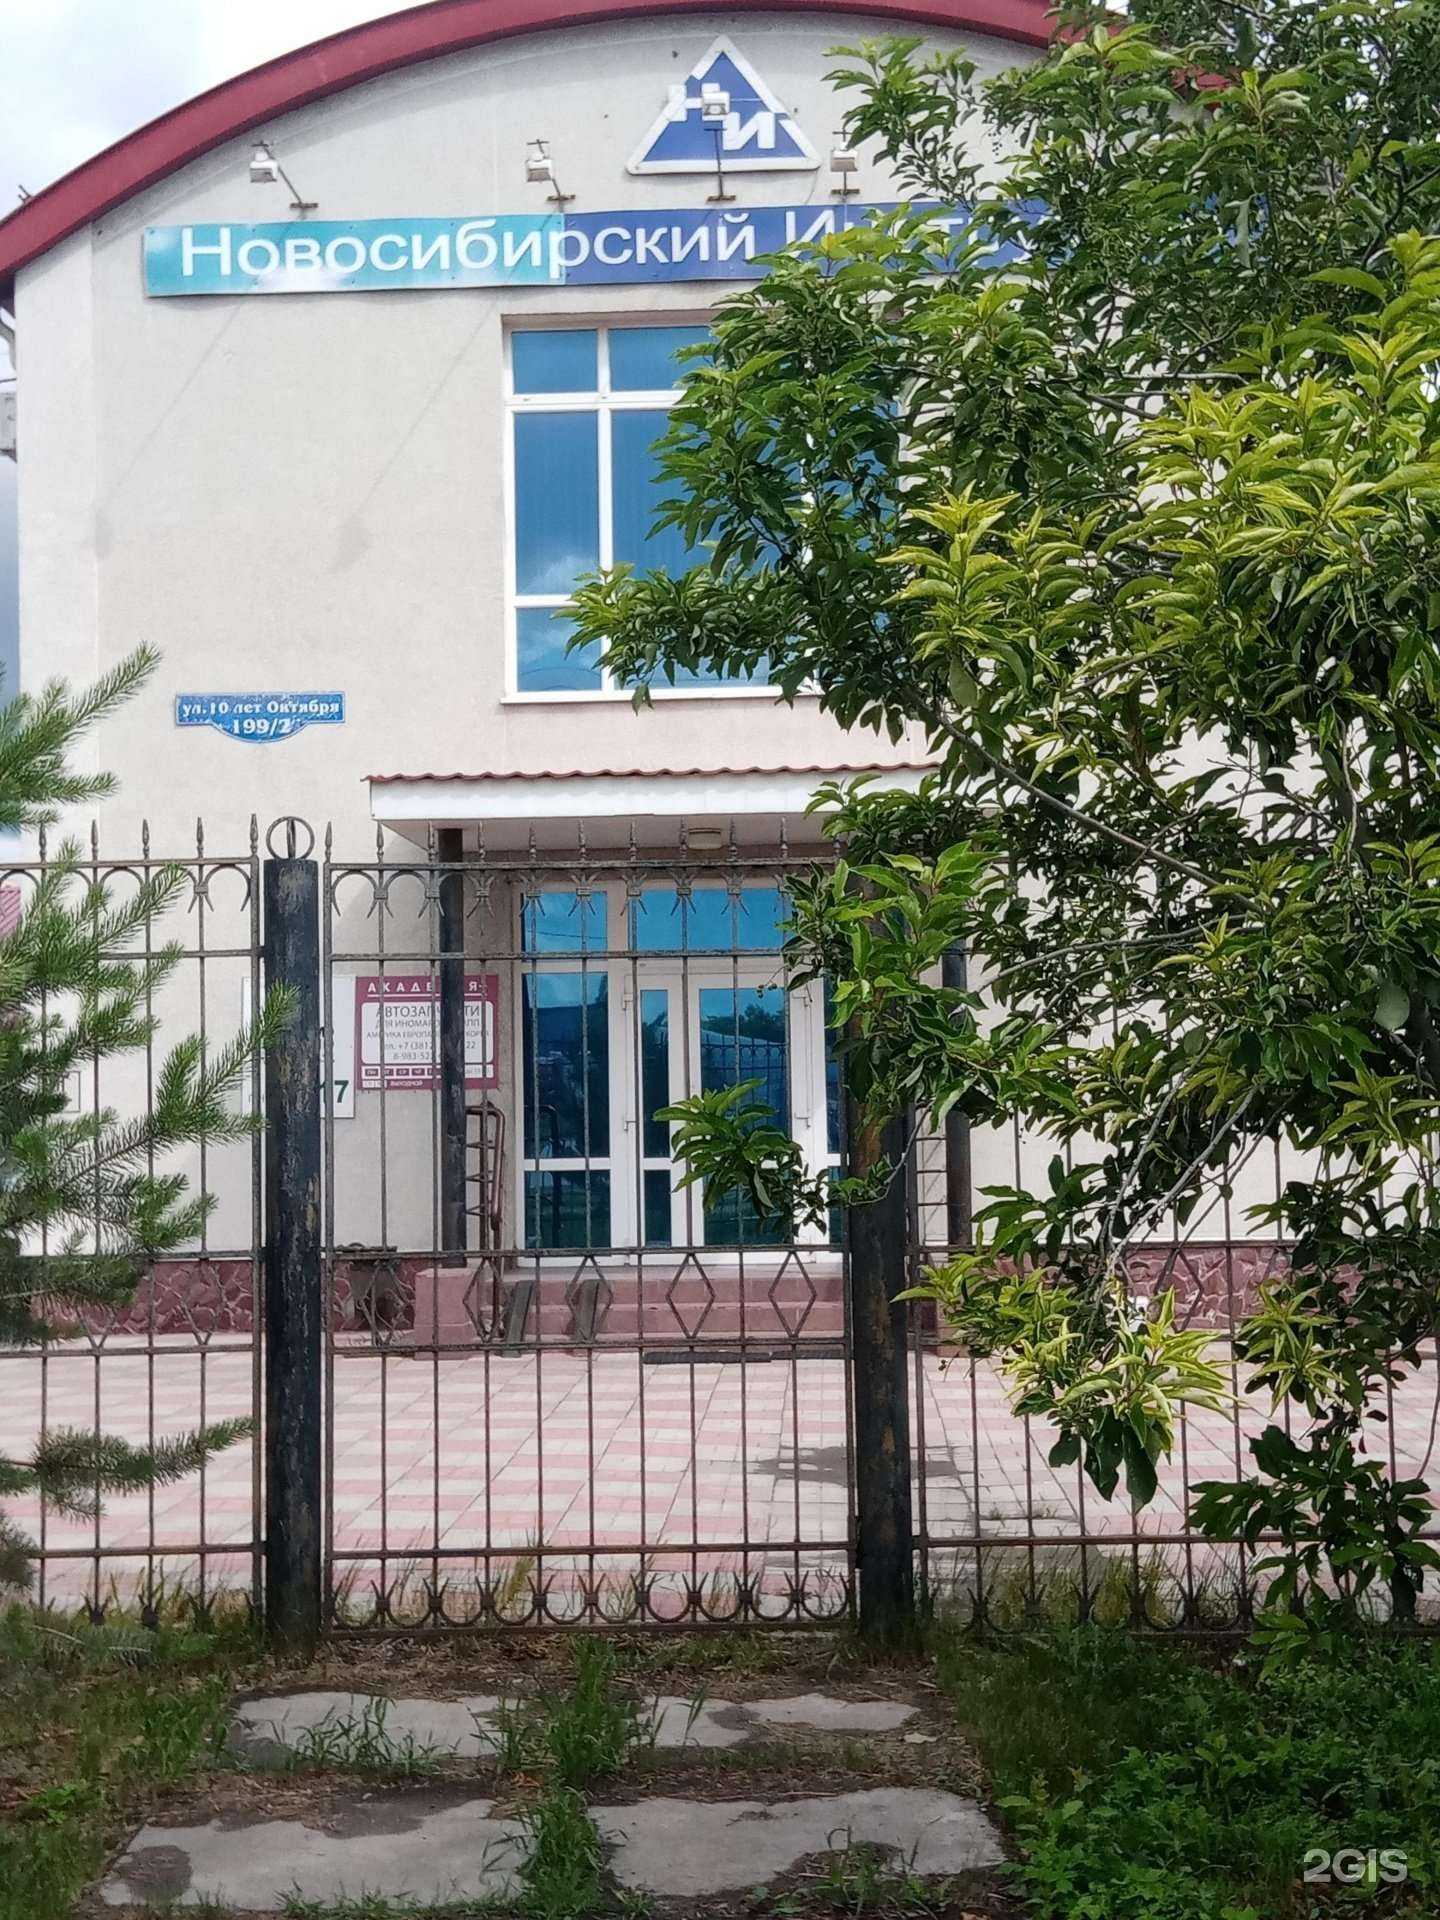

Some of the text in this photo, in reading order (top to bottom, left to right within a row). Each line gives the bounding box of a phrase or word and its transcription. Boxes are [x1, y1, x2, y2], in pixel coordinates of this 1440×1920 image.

[181, 211, 755, 280] Новосибирский
[233, 702, 261, 714] лет
[266, 699, 340, 715] Октября
[233, 717, 291, 736] 199/2
